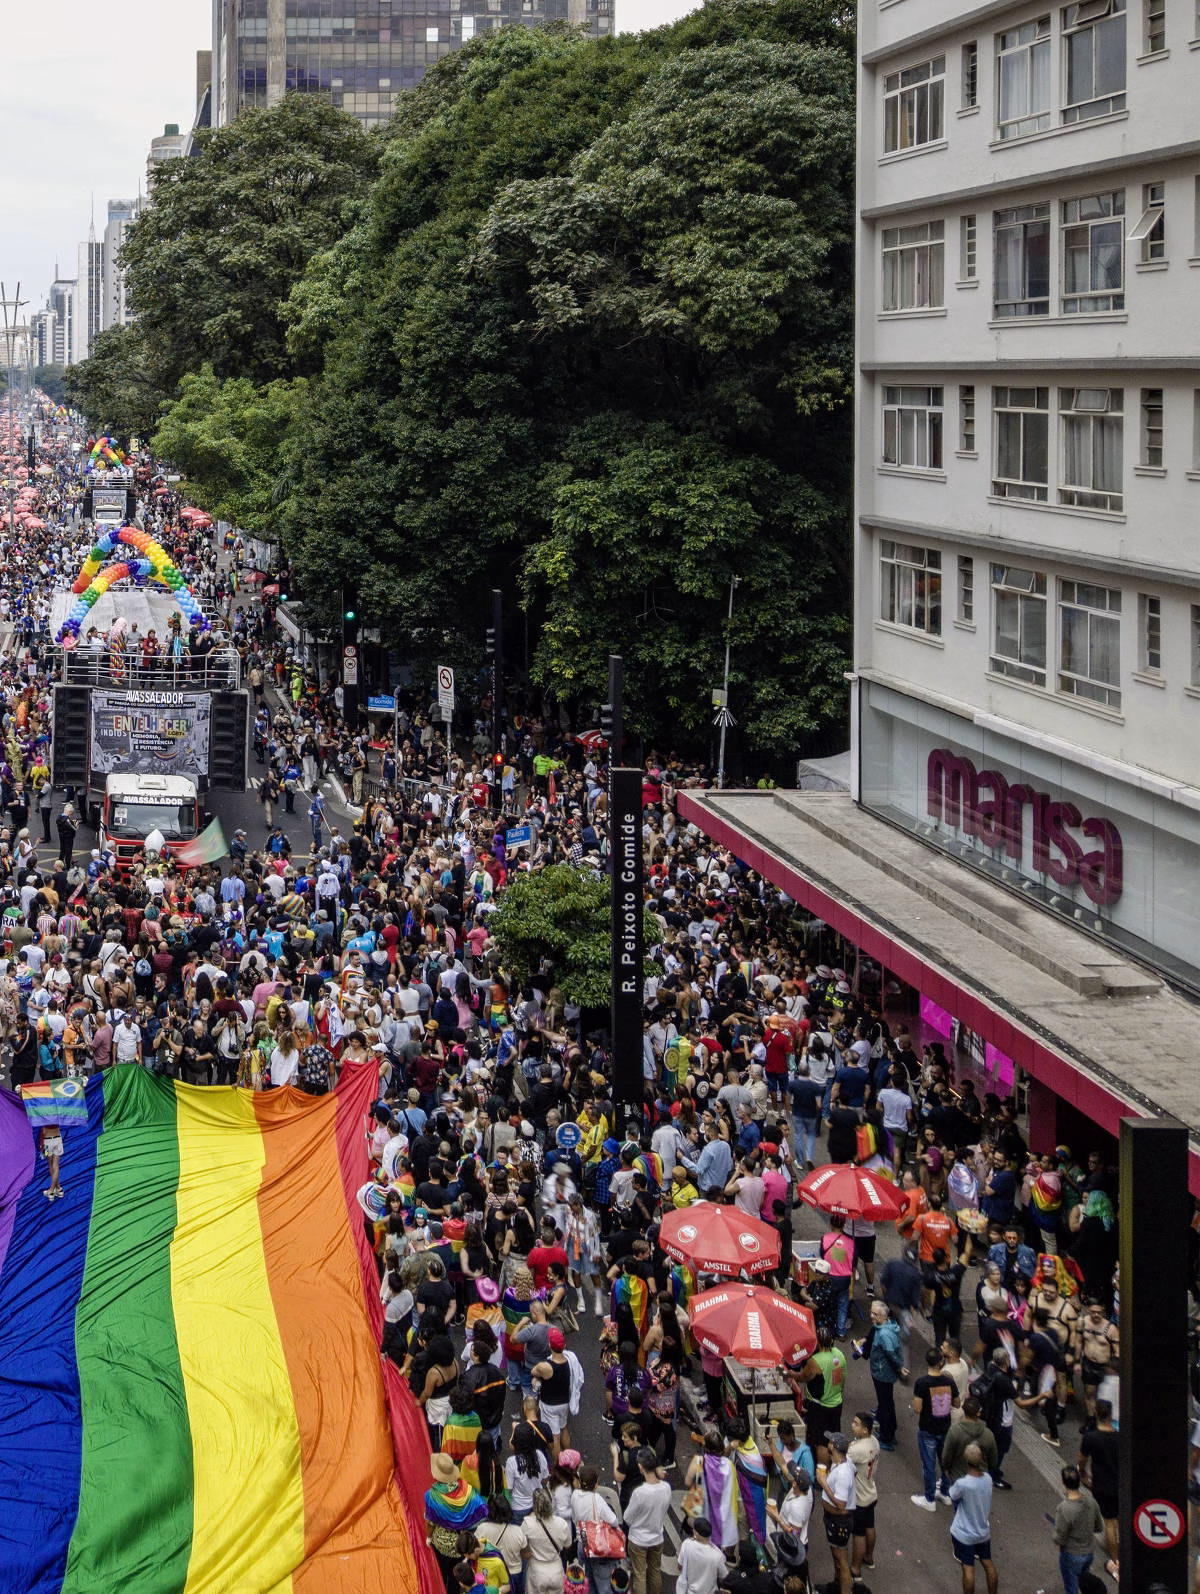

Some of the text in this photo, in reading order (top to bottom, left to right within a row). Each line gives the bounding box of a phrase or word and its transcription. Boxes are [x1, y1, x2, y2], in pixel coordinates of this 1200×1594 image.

[126, 690, 184, 704] AVASSALADOR
[113, 714, 188, 733] ENVELHECER
[123, 796, 183, 805] AVASSALADOR
[507, 829, 525, 838] Paulista
[927, 748, 1123, 906] marisa
[621, 813, 636, 992] R. Peixoto Gomide
[809, 1170, 836, 1191] BRAHMA
[667, 1244, 685, 1261] AMSTEL
[704, 1261, 732, 1272] AMSTEL
[751, 1259, 772, 1271] AMSTEL
[695, 1293, 728, 1312] BRAHMA
[747, 1312, 763, 1349] BRAHMA
[703, 1337, 720, 1354] BRAHMA
